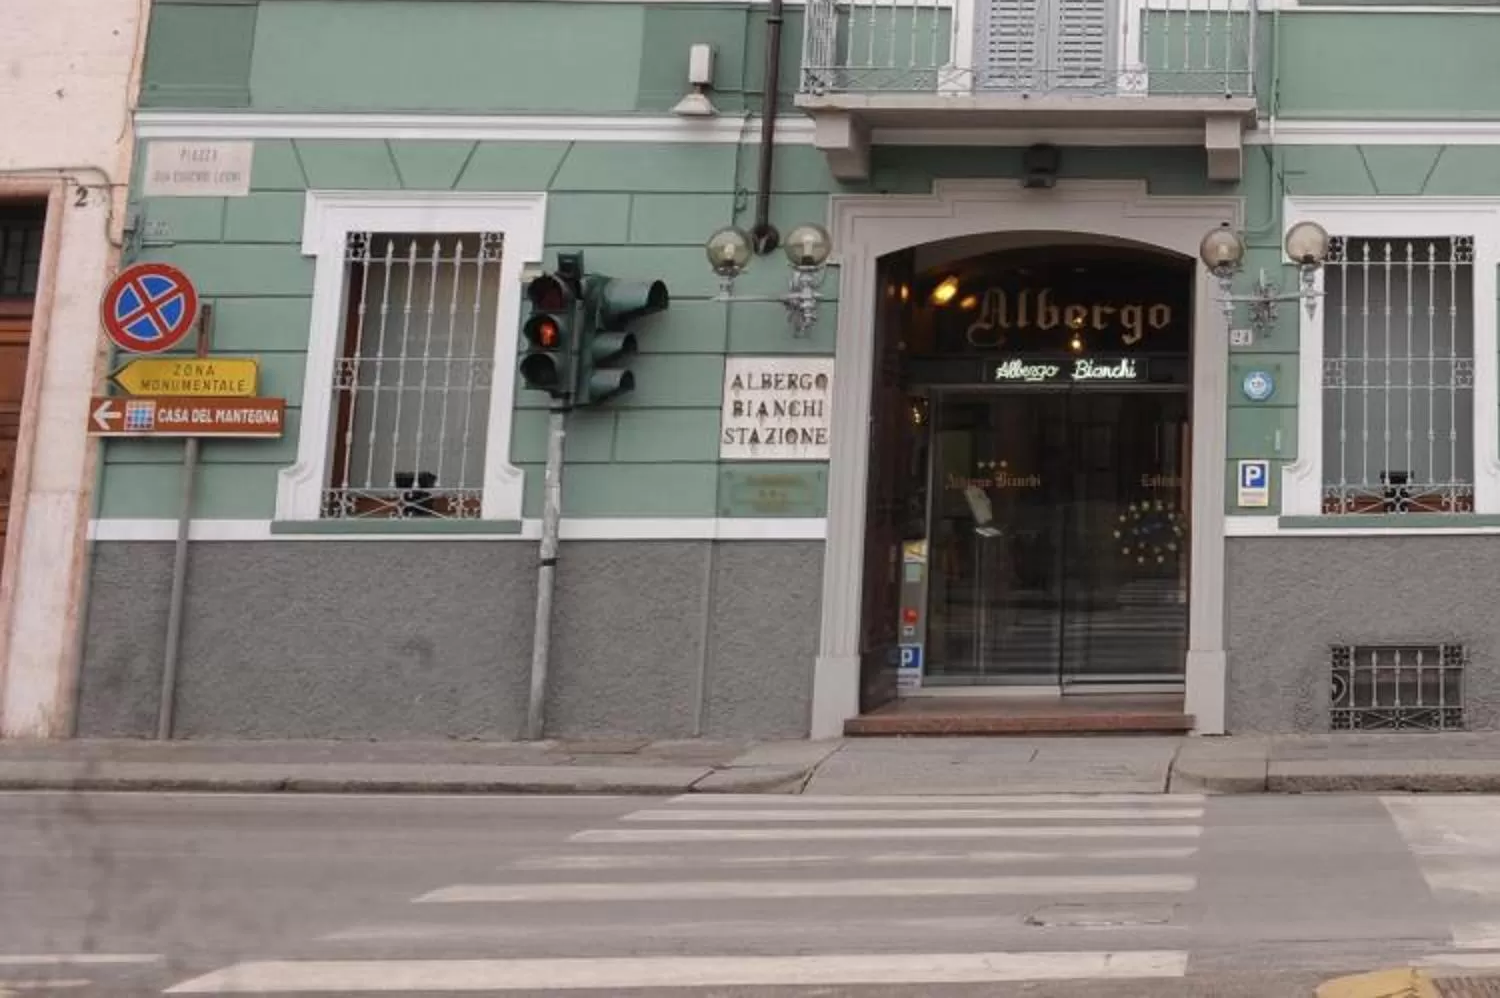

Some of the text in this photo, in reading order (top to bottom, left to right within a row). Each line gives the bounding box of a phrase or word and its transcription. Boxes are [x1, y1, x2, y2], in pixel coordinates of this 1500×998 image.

[74, 186, 89, 207] 2
[967, 287, 1173, 346] Albergo
[173, 361, 216, 376] ZONA
[995, 357, 1138, 381] Albergo Bianchi
[140, 377, 247, 391] MONUMENTALE
[730, 372, 829, 391] ALBERGO
[158, 409, 280, 425] CASA DEL MANTEGNA
[732, 399, 824, 418] BIANCHI
[723, 427, 829, 445] STAZIONE
[1245, 465, 1261, 487] P
